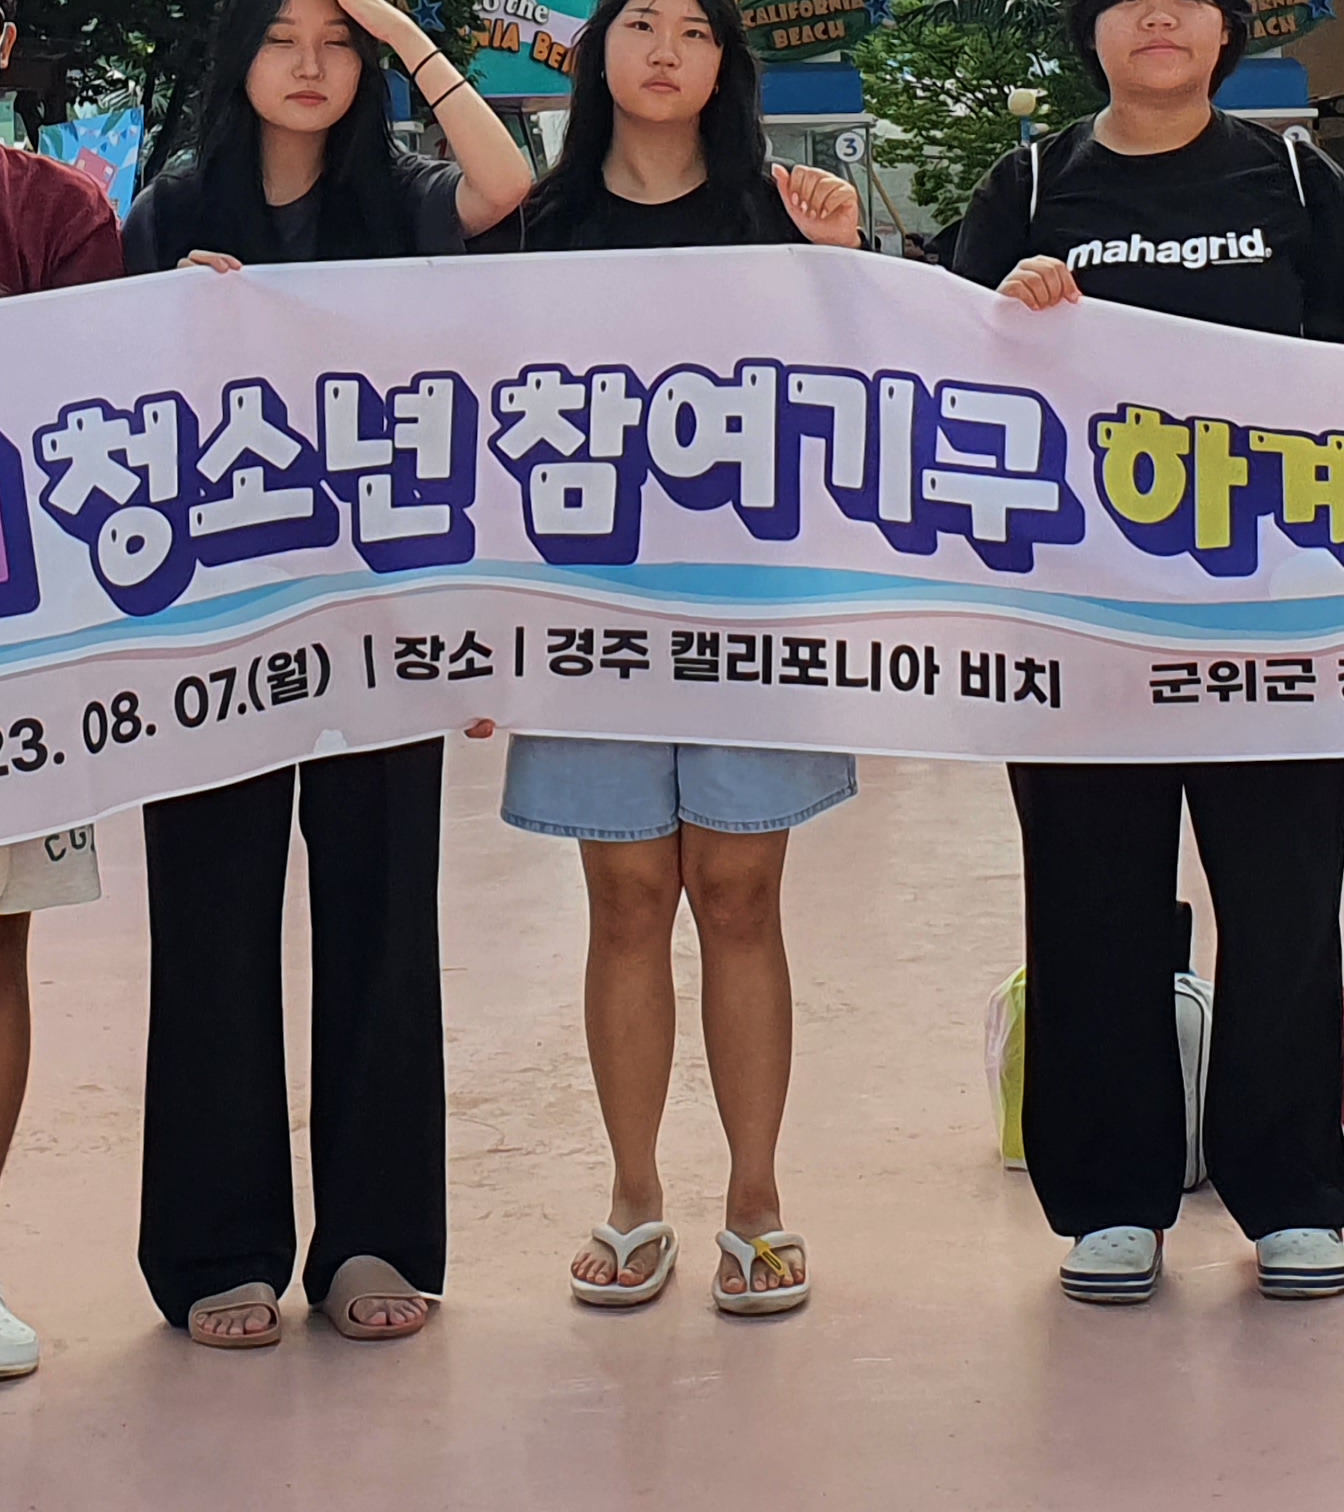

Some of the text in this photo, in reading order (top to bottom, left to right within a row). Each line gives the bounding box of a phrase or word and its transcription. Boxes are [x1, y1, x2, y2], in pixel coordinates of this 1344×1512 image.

[772, 19, 846, 49] BEACH
[842, 138, 859, 157] 3
[35, 368, 478, 616] 청소년
[489, 358, 1087, 573] 참여기구
[81, 690, 157, 755] 08.
[393, 627, 495, 682] 장소
[545, 625, 651, 680] 경주
[669, 628, 941, 695] 캘리포니아
[959, 649, 1062, 709] 비치
[1148, 658, 1317, 705] 군위군
